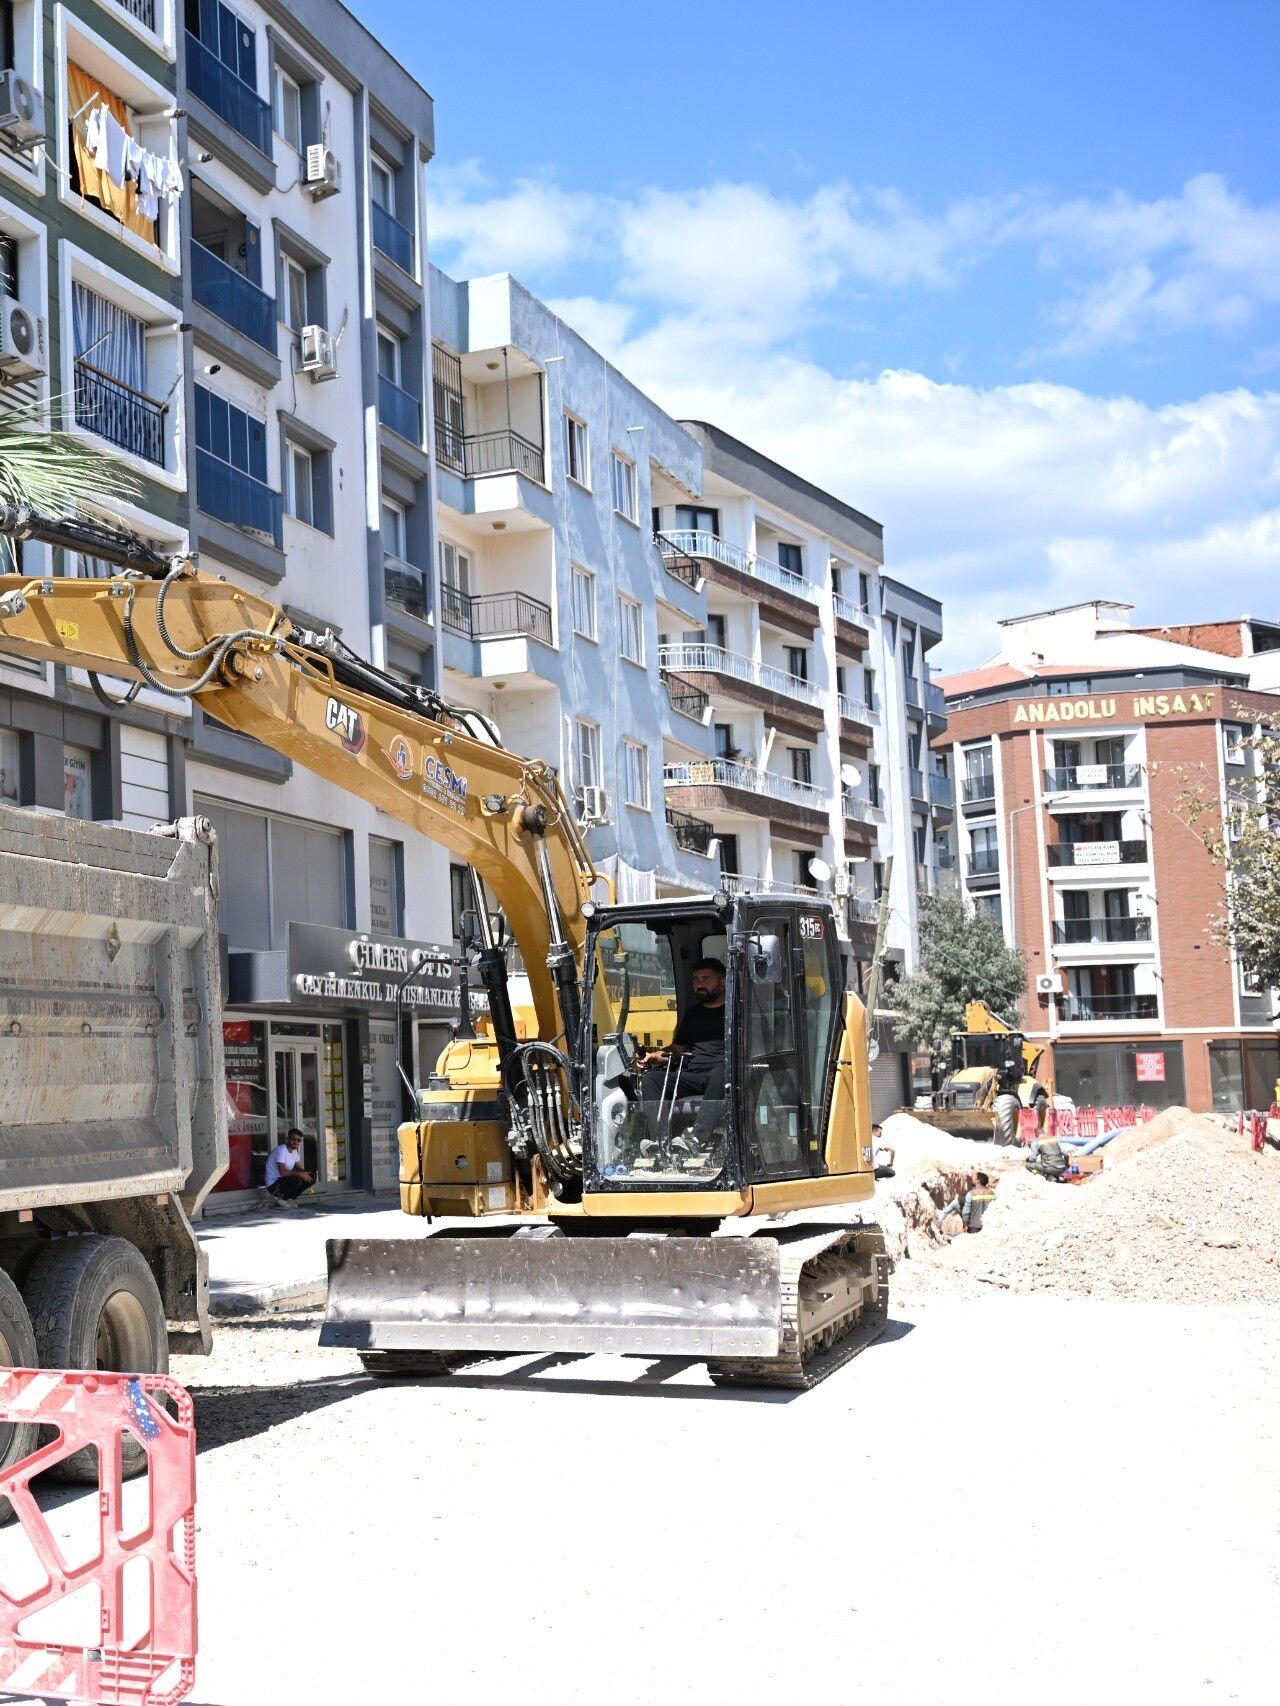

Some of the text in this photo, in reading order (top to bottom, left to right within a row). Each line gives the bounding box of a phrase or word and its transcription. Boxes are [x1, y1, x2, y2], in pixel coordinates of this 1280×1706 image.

[326, 697, 358, 742] CAT
[1014, 699, 1116, 723] ANADOLU
[70, 757, 86, 770] GİYİM
[800, 917, 815, 937] 315
[350, 934, 452, 978] ÇİMEN OFİS
[296, 972, 383, 1001] GAYRİMENKUL
